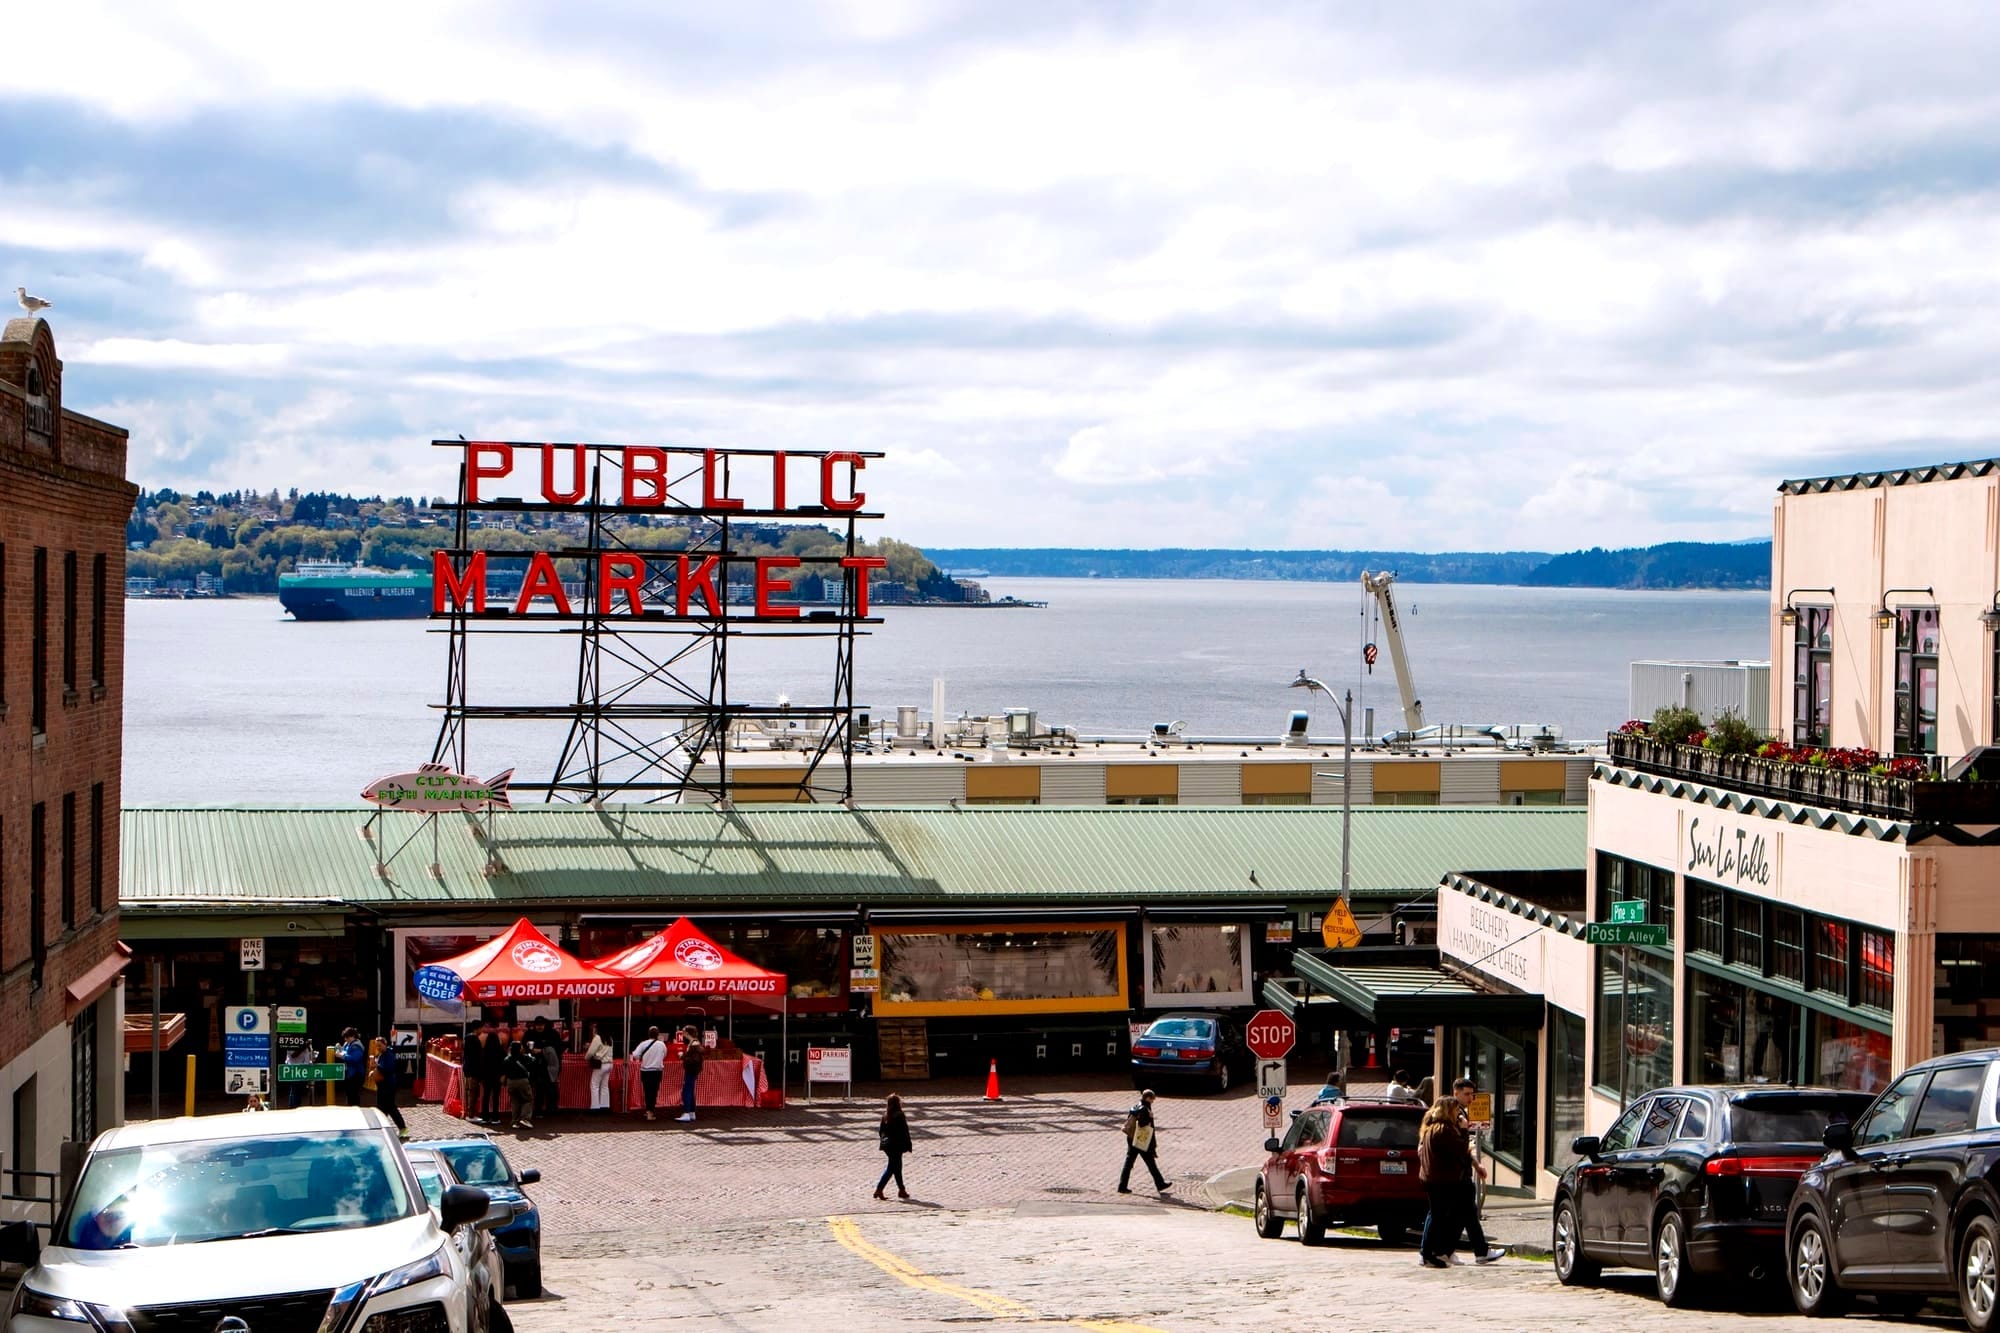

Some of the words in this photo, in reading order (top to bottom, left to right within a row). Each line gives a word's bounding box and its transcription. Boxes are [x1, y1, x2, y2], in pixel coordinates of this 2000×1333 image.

[465, 441, 867, 511] PUBLIC
[432, 550, 887, 617] MARKET
[344, 587, 375, 597] WALLENIUS
[416, 775, 460, 787] CITY
[378, 789, 418, 801] FISH
[424, 789, 495, 801] MARKET
[1688, 817, 1716, 871] Sur
[1717, 825, 1735, 878] La
[1736, 828, 1770, 886] Table
[1334, 909, 1348, 917] YIELD
[1614, 904, 1626, 920] Pine
[1470, 905, 1510, 942] BEECHER'S
[855, 937, 873, 945] ONE
[1591, 925, 1621, 941] Post
[1627, 931, 1655, 945] Alley
[243, 940, 261, 949] ONE
[855, 946, 873, 954] WAY
[243, 949, 262, 957] WAY
[1453, 927, 1497, 966] HANDMADE
[1499, 948, 1527, 981] CHEESE
[420, 977, 458, 992] APPLE
[502, 984, 553, 996] WORLD
[557, 983, 615, 995] FAMOUS
[665, 980, 715, 992] WORLD
[719, 980, 776, 991] FAMOUS
[418, 984, 455, 999] CIDER
[279, 1036, 305, 1045] 87505
[1250, 1026, 1292, 1044] STOP
[227, 1051, 233, 1060] 2
[809, 1050, 821, 1059] NO
[282, 1066, 308, 1079] Pike
[314, 1069, 323, 1078] Pl
[1261, 1087, 1283, 1096] ONLY
